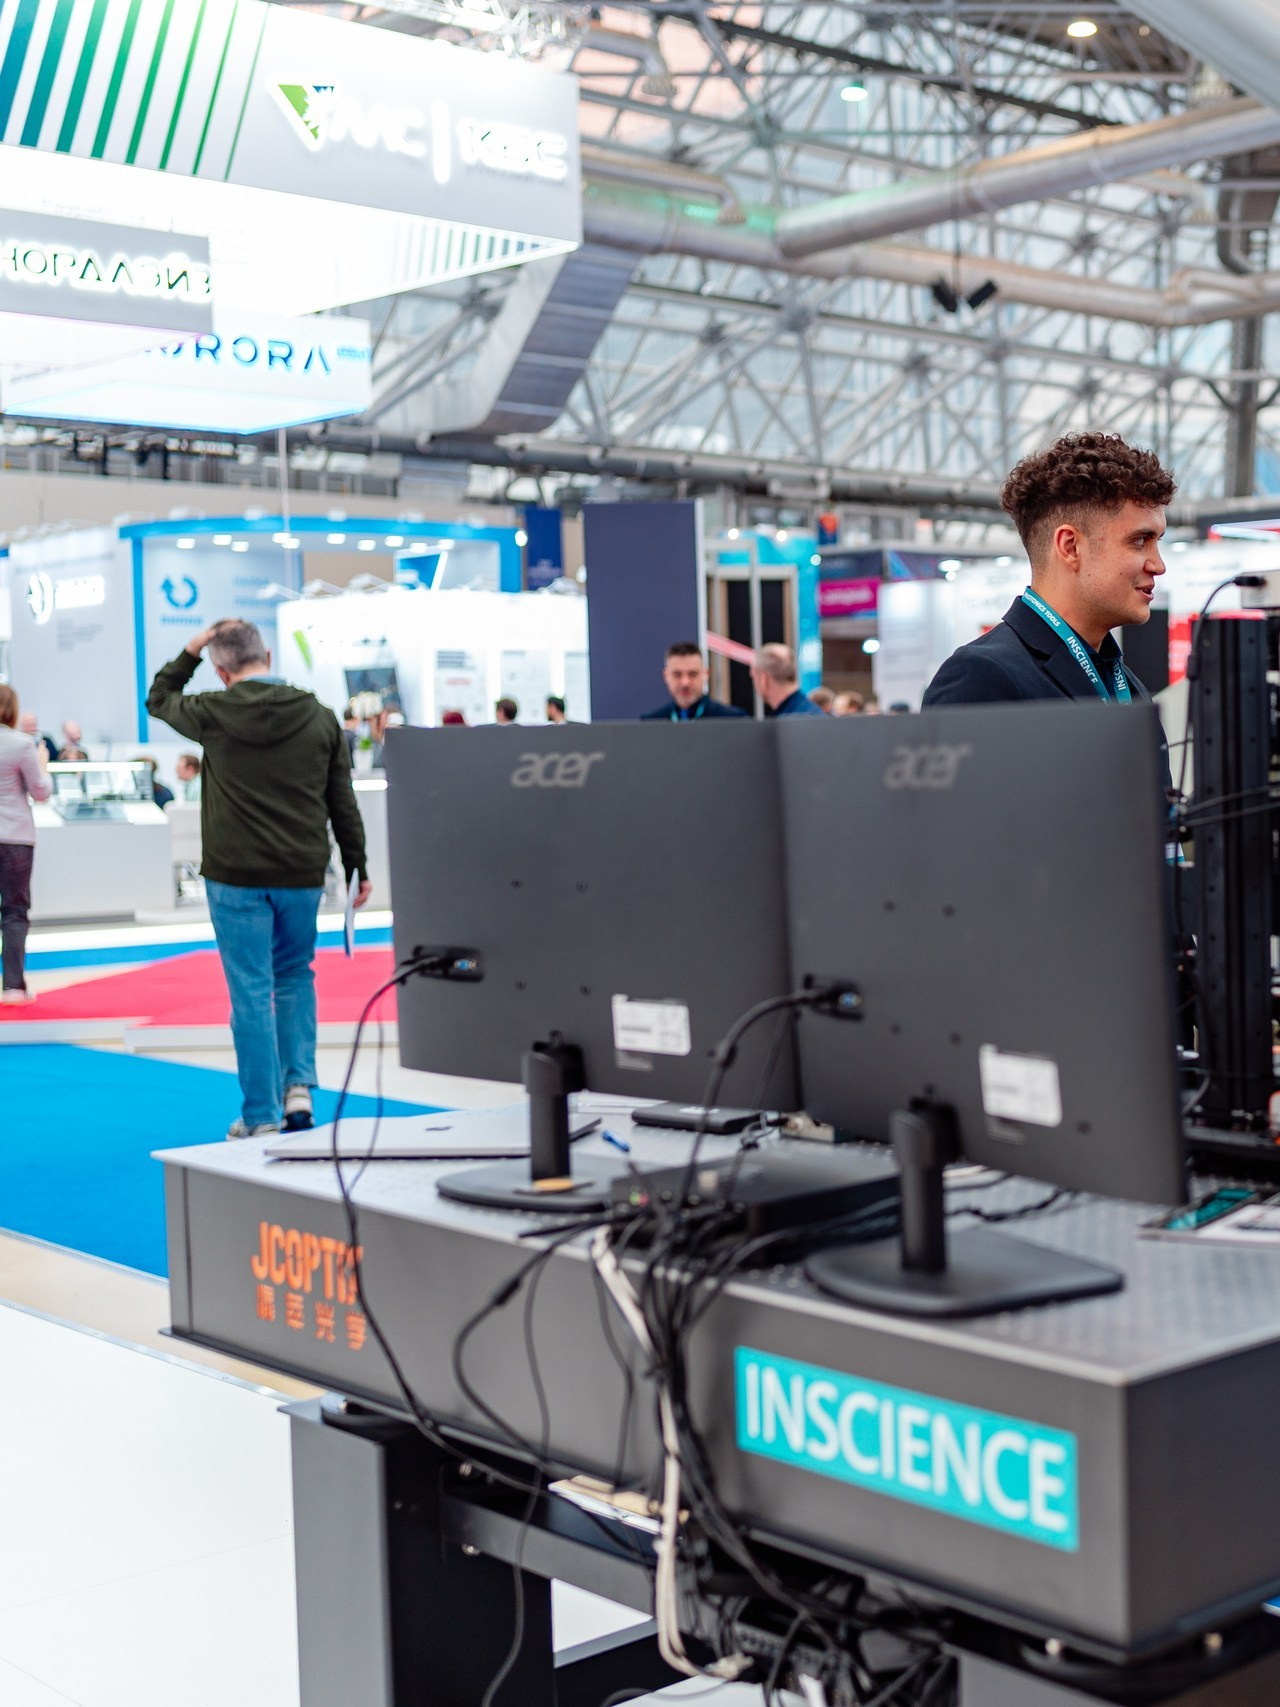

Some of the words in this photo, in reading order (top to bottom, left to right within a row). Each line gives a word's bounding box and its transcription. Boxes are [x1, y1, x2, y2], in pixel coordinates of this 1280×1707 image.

[1045, 610, 1061, 627] TOOLS
[1112, 659, 1127, 691] INSCIE
[511, 751, 605, 789] acer
[884, 741, 973, 790] acer
[744, 1364, 1070, 1534] INSCIENCE
